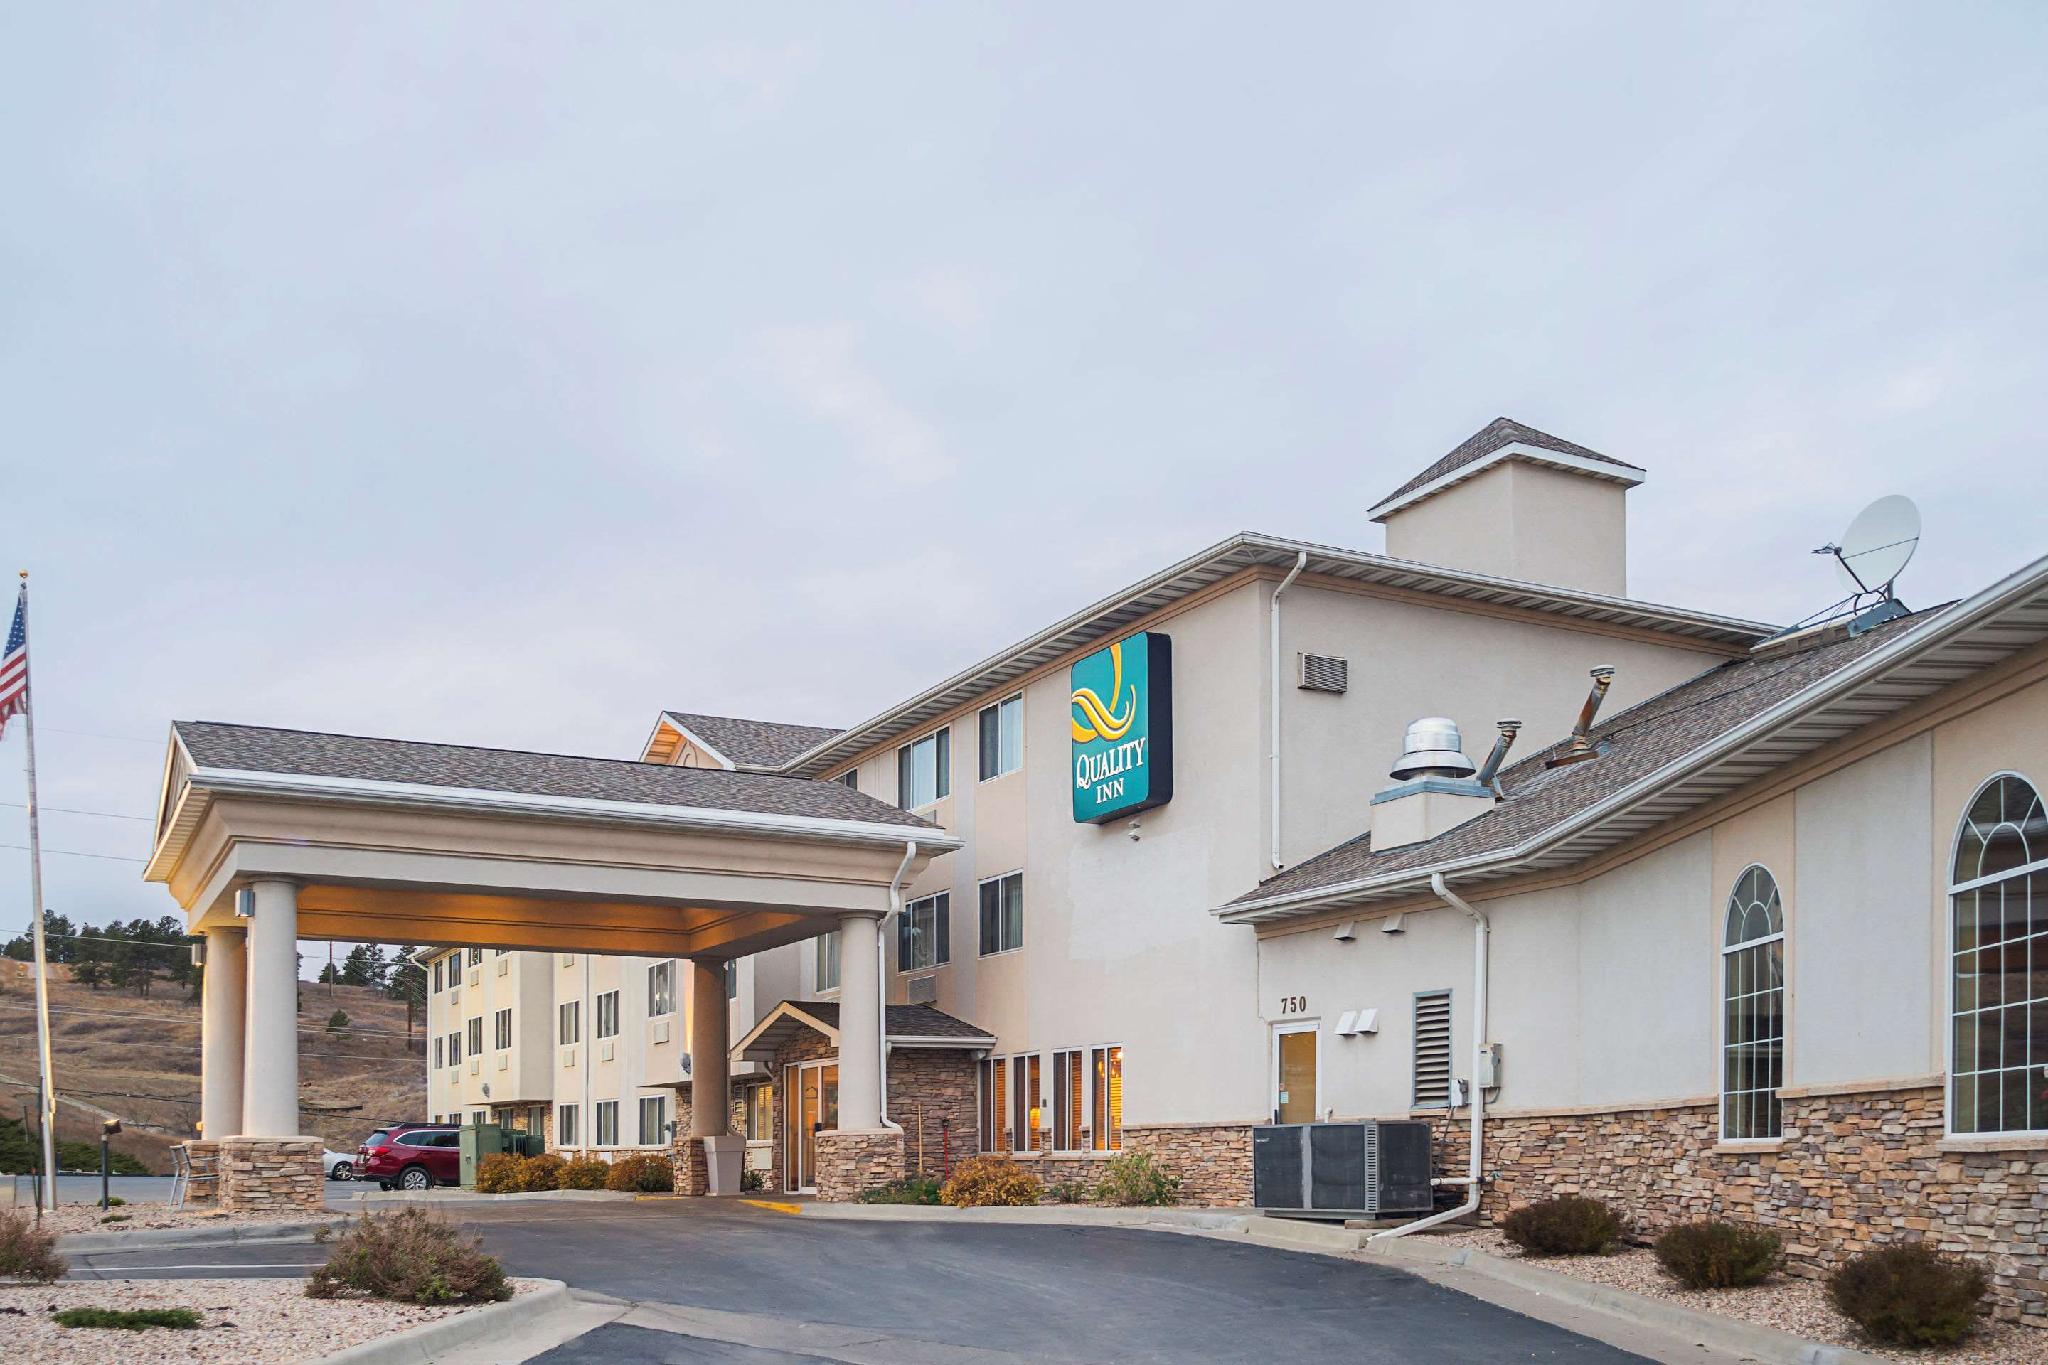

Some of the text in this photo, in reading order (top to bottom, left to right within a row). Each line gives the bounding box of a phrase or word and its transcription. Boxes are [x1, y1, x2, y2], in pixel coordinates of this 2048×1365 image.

[1076, 737, 1146, 789] QUALITY
[1096, 778, 1125, 804] INN
[1280, 995, 1307, 1015] 750
